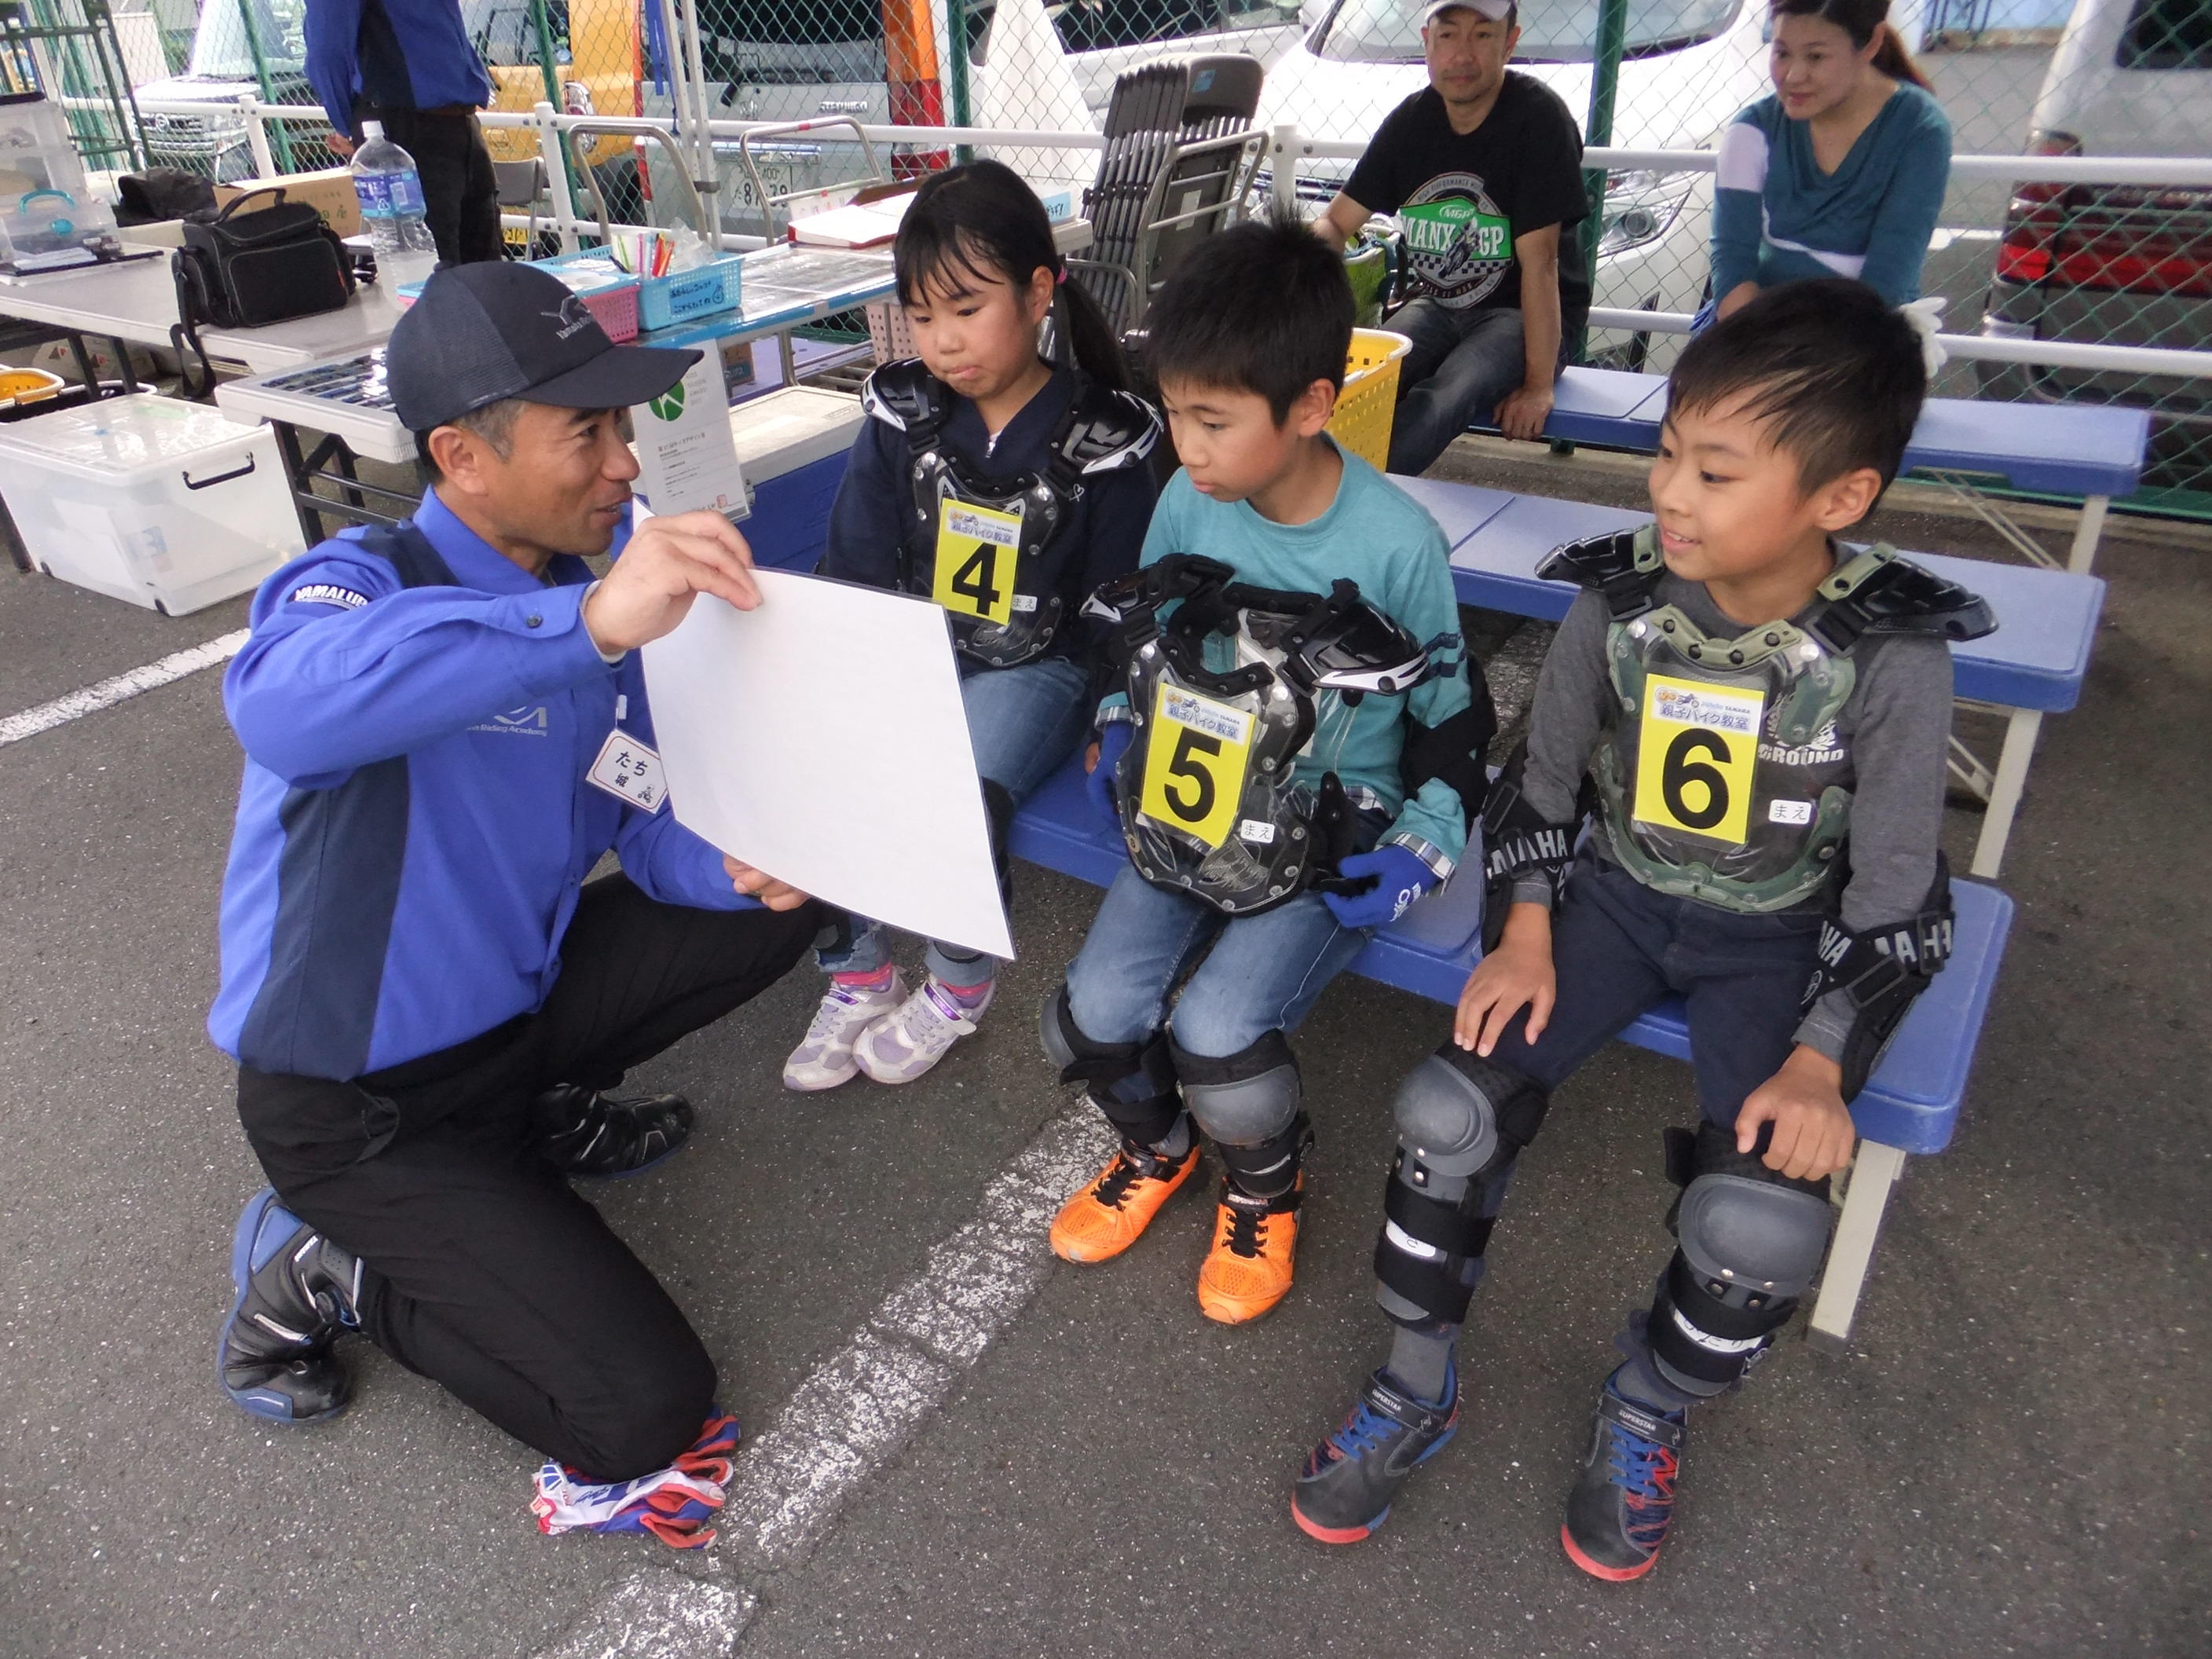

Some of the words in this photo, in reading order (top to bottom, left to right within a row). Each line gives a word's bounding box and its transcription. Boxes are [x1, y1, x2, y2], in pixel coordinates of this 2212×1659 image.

[1478, 225, 1504, 257] GP
[951, 542, 1000, 617] 4
[1660, 701, 1750, 731] 親子バイク教室
[1164, 726, 1222, 823] 5
[1661, 727, 1733, 830] 6
[1774, 804, 1807, 820] まえ
[1244, 823, 1270, 840] まえ
